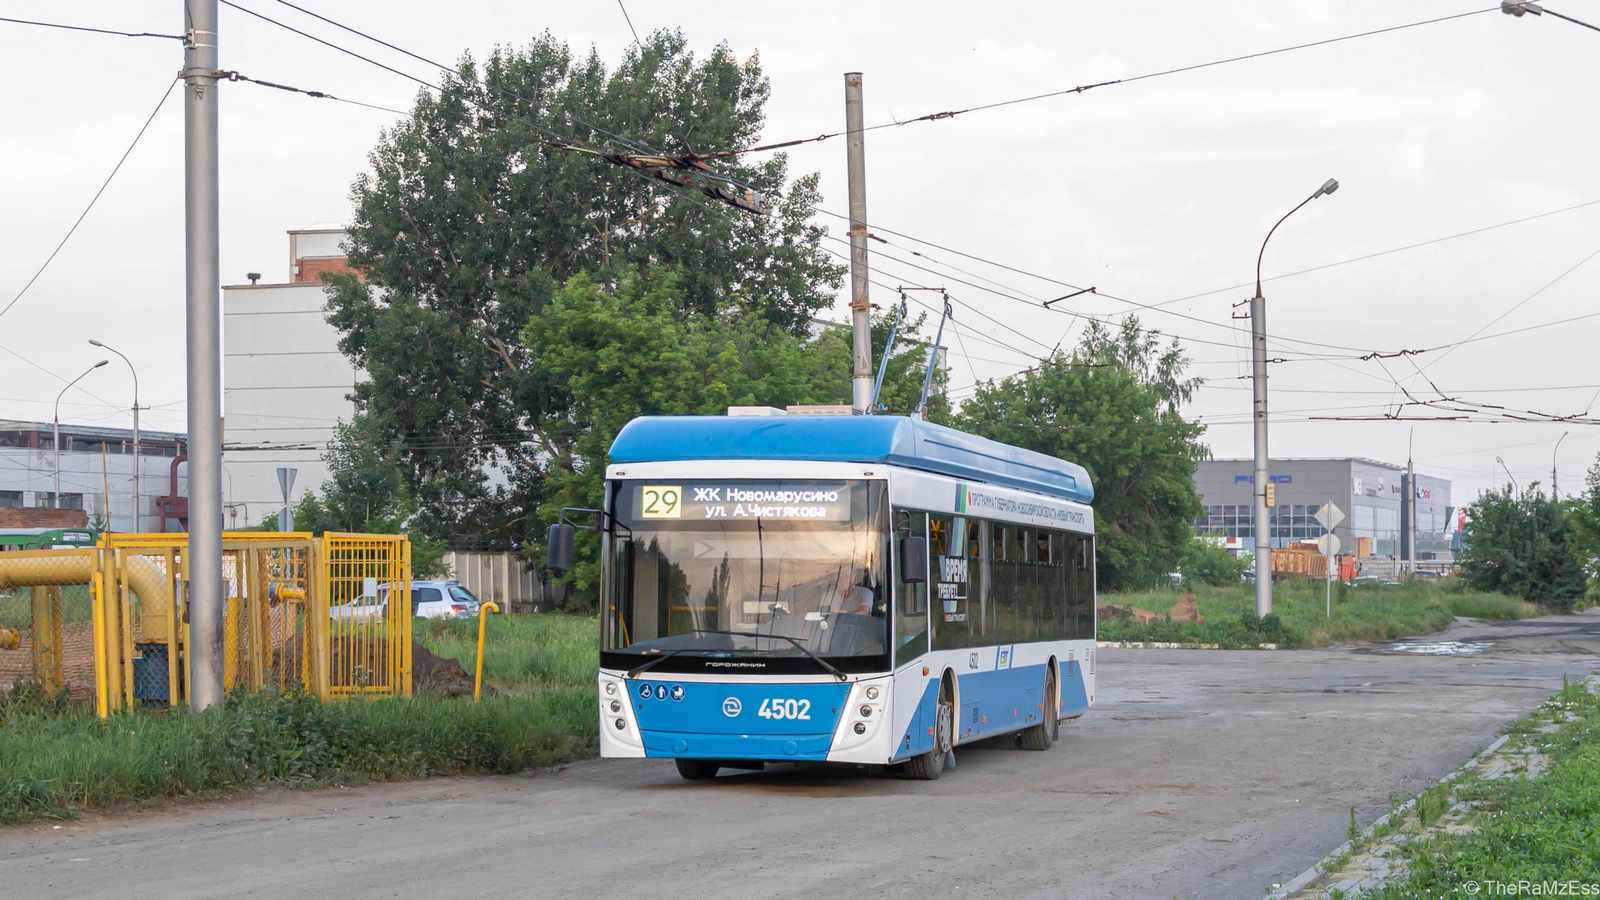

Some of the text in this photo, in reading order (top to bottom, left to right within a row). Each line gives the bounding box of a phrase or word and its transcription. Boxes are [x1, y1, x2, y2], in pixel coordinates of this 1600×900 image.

[645, 490, 678, 514] 29
[693, 488, 839, 503] ЖК Новомарусино
[705, 503, 826, 518] ул. А.Чистякова
[946, 558, 967, 582] ВРЕМЯ
[758, 698, 811, 720] 4502
